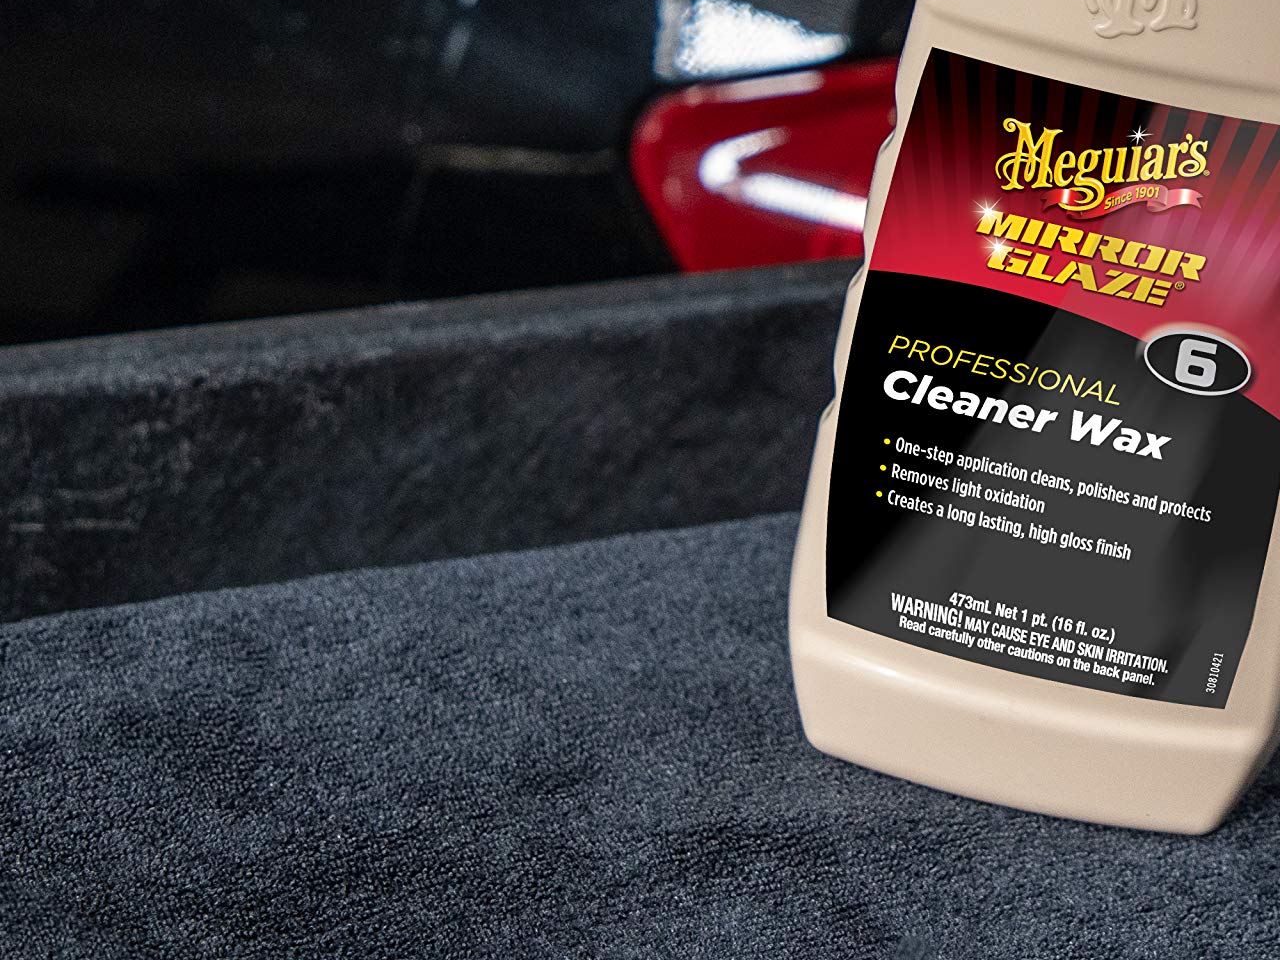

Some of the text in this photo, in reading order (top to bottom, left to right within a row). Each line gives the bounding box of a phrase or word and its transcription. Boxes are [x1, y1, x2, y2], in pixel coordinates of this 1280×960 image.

[1103, 186, 1160, 210] Since 1901
[976, 210, 1208, 281] MIRROR
[887, 335, 1121, 406] PROFESSIONAL
[1174, 338, 1218, 387] 6
[883, 370, 1172, 460] Cleaner Wax
[891, 463, 1045, 514] Removes light oxidation
[895, 437, 1212, 522] One-step application cleans, polishes and protects
[887, 490, 1132, 561] Creates a long lasting, high gloss finish
[891, 592, 1169, 674] WARNING! MAY CAUSE EYE AND SKIN IRRITATION.
[899, 615, 1155, 686] Read carefully other cautions on the back panel.
[949, 592, 1116, 644] 473mL Net 1 pt. (16 fl. oz.)
[1205, 652, 1224, 694] 30810421
